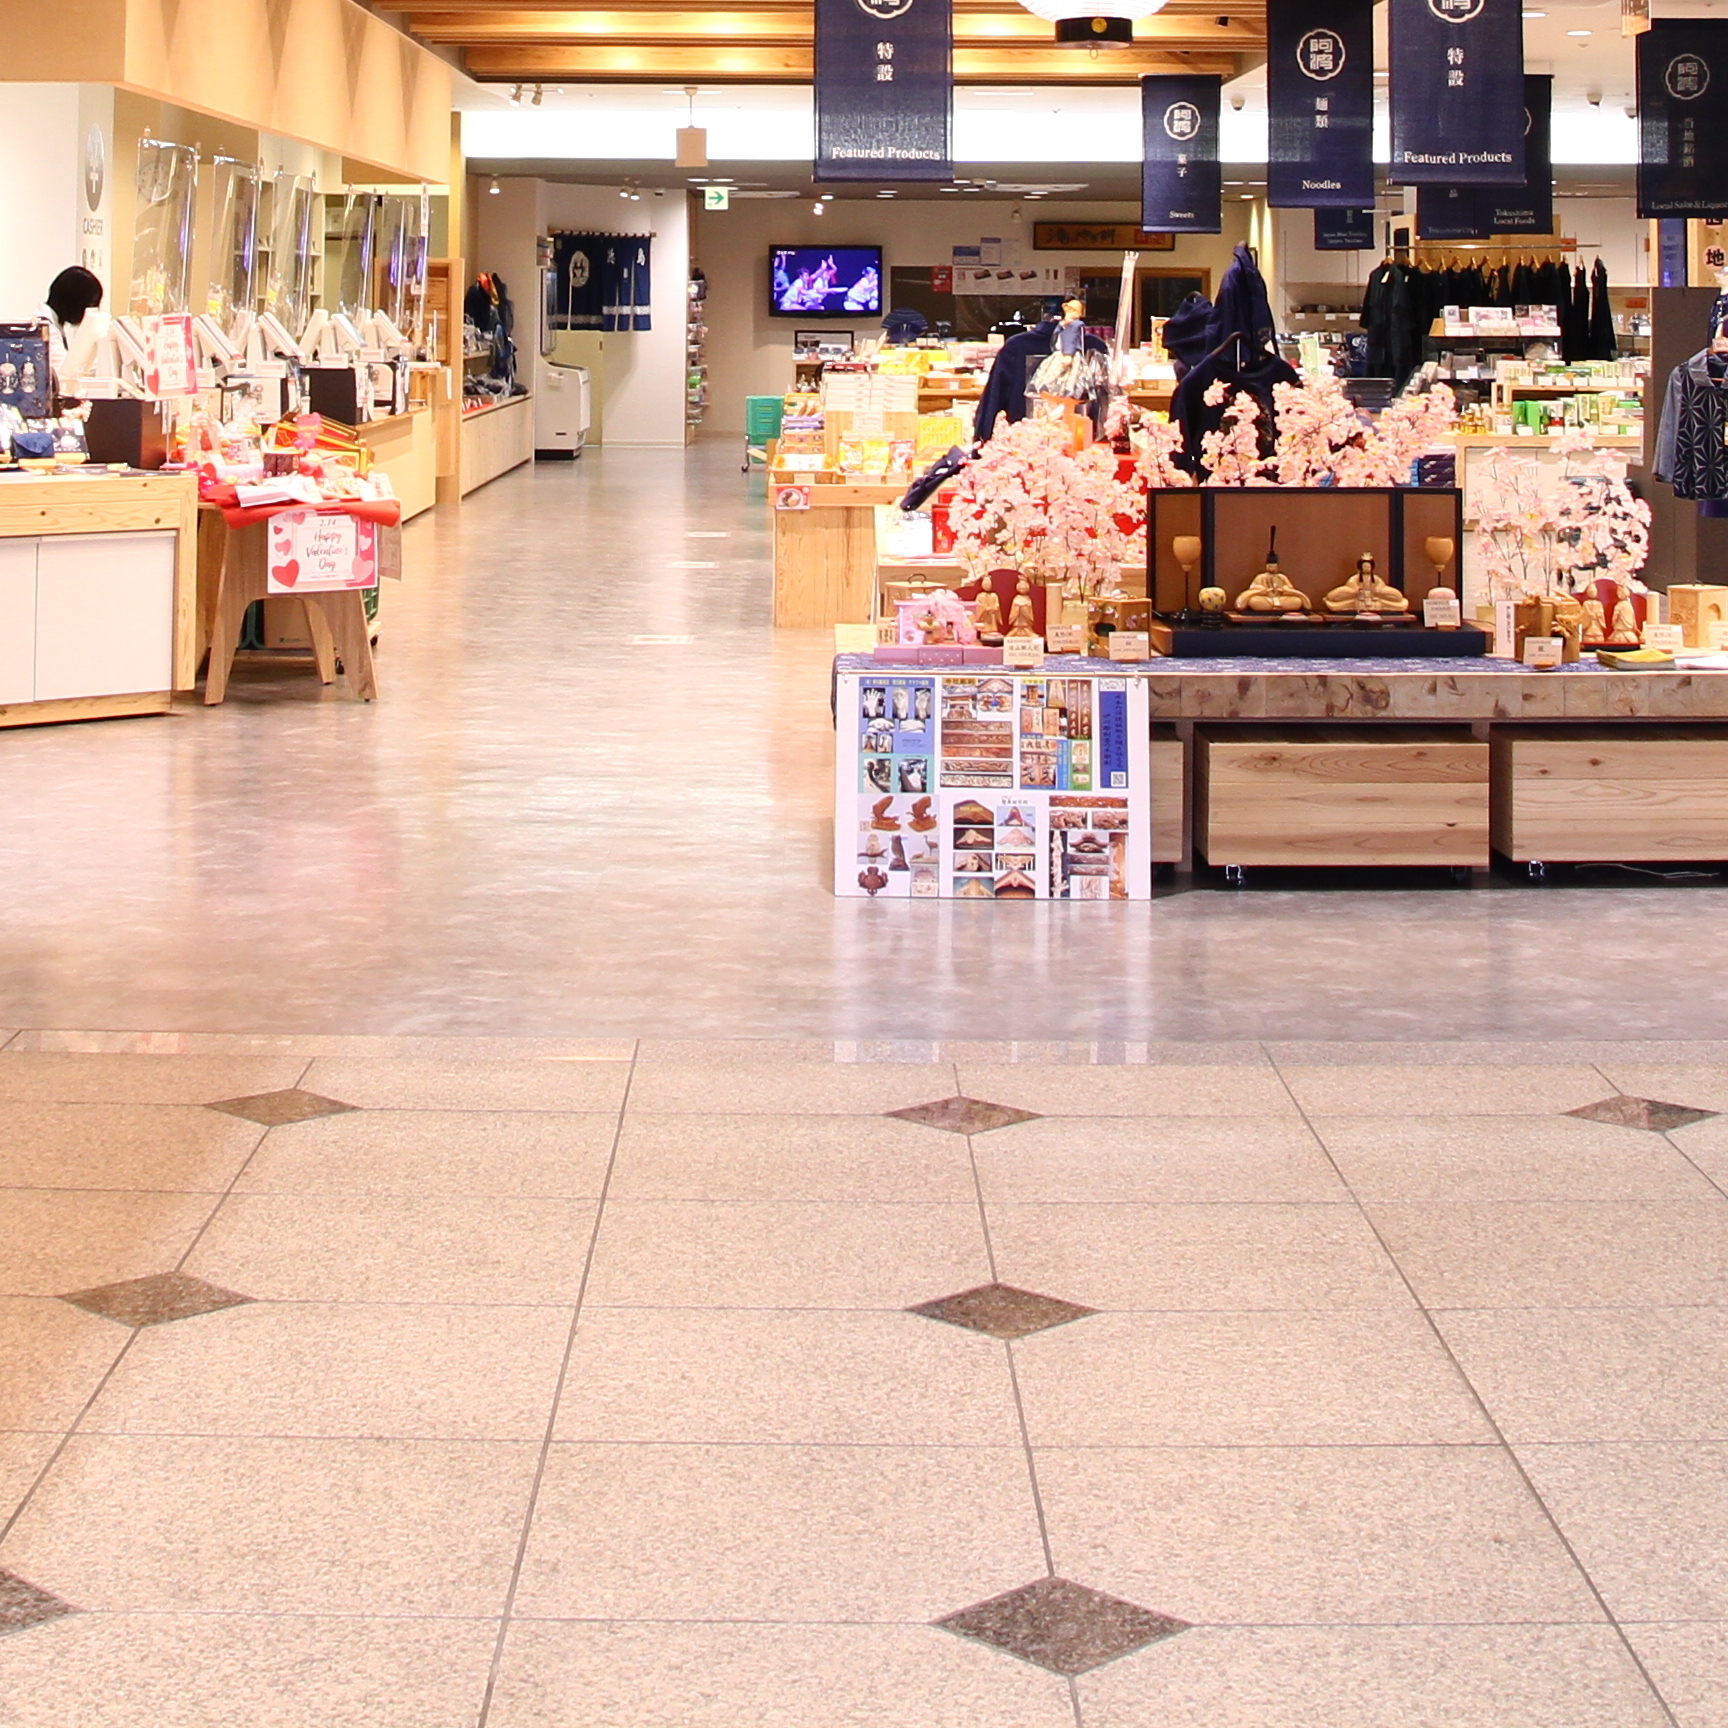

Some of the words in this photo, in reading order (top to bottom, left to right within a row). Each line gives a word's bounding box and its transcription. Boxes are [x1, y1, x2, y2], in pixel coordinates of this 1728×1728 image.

[876, 41, 895, 82] 特設
[1309, 38, 1334, 71] 阿波
[1446, 46, 1464, 86] 特設
[832, 146, 885, 161] Featured
[888, 146, 941, 161] Products
[1403, 151, 1456, 165] Featured
[1459, 150, 1512, 165] Products
[1302, 180, 1341, 191] Noodles
[1169, 211, 1195, 219] Sweets
[314, 530, 342, 547] Happy
[318, 557, 336, 571] Day
